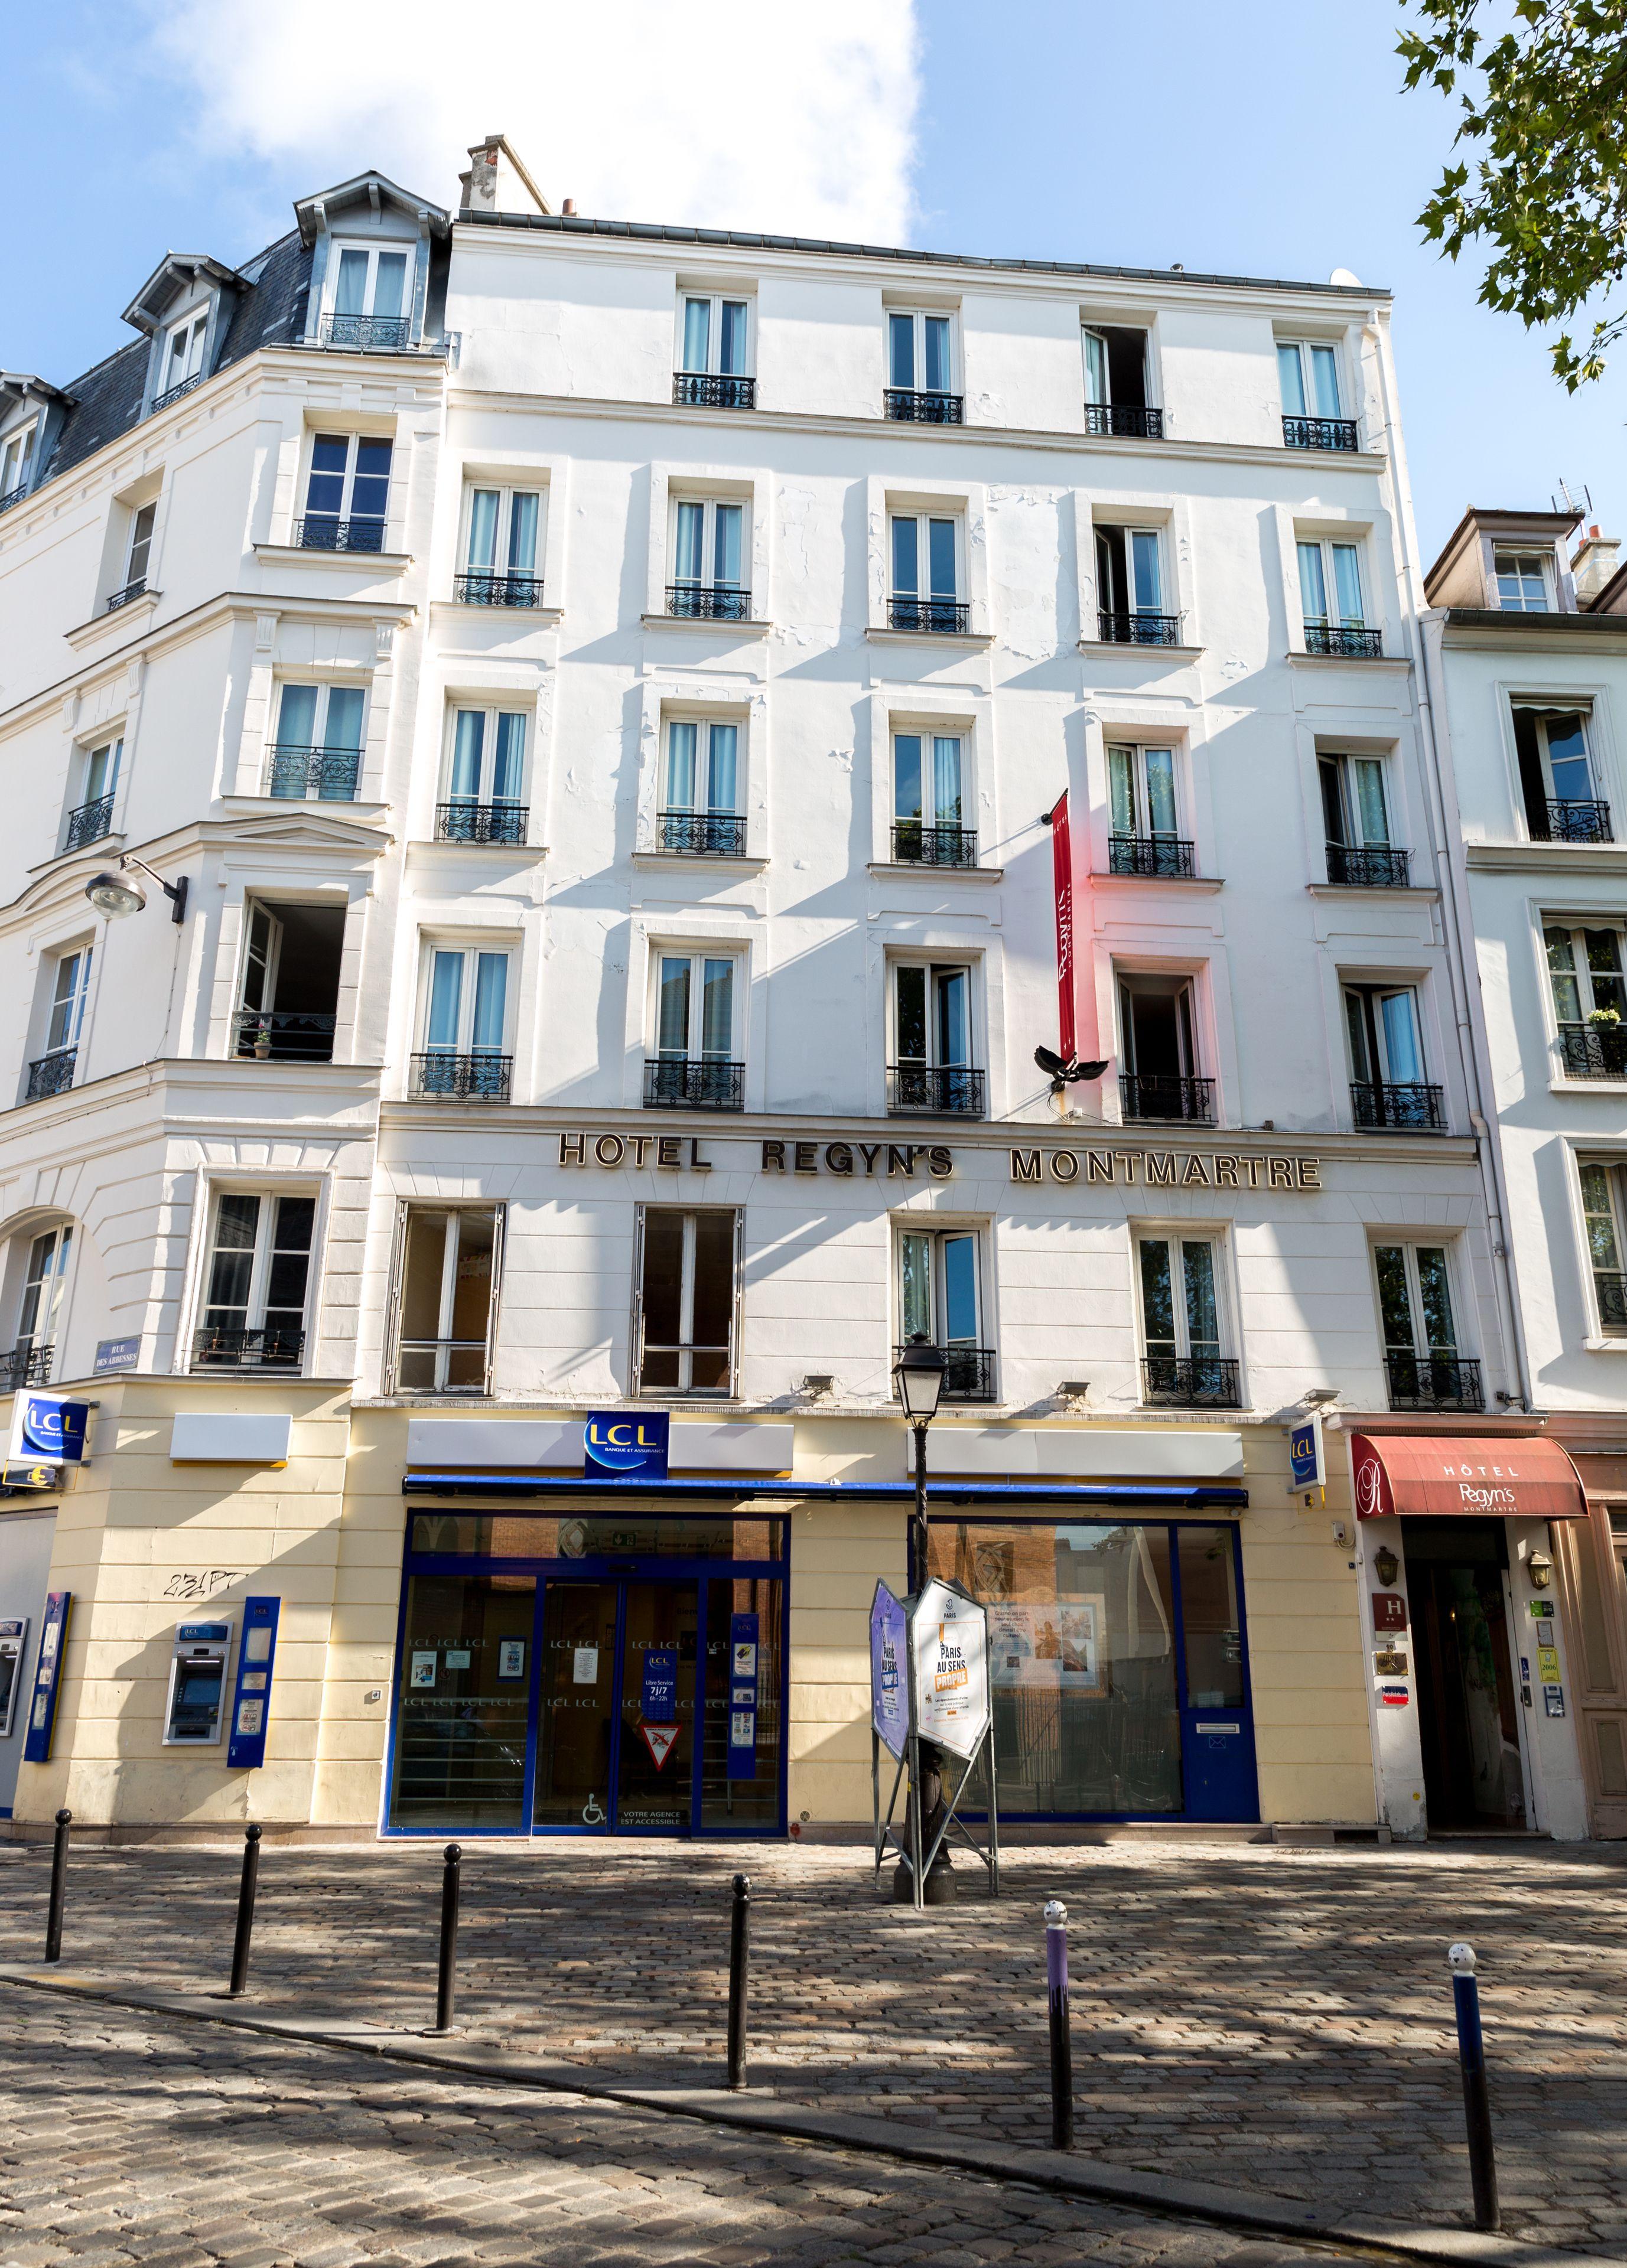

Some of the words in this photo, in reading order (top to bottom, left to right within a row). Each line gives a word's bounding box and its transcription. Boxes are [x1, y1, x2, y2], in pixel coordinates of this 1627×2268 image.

[558, 1132, 712, 1171] HOTEL
[760, 1139, 954, 1179] REGYN'S
[1009, 1148, 1322, 1190] MONTMARTRE
[111, 1344, 125, 1354] RUE
[96, 1358, 108, 1367] DES
[108, 1353, 137, 1365] ABBESSES
[31, 1410, 78, 1433] LCL
[590, 1424, 657, 1446] LCL
[1292, 1438, 1313, 1458] LCL
[1444, 1464, 1519, 1477] HÔTEL
[1356, 1458, 1383, 1514] R
[1459, 1483, 1515, 1507] Regyn's
[1387, 1601, 1403, 1615] H
[409, 1639, 434, 1647] LCL
[437, 1639, 461, 1647] LCL
[466, 1639, 490, 1647] LCL
[551, 1640, 574, 1648] LCL
[578, 1640, 603, 1648] LCL
[632, 1641, 656, 1649] LCL
[660, 1641, 684, 1650] LCL
[884, 1647, 894, 1659] PARIS
[941, 1647, 962, 1660] PARIS
[937, 1661, 946, 1673] AU
[948, 1660, 966, 1672] SENS
[936, 1670, 967, 1689] PROPRE
[650, 1687, 668, 1696] 7j/7
[404, 1698, 428, 1706] LCL
[432, 1698, 457, 1706] LCL
[461, 1698, 486, 1706] LCL
[490, 1698, 515, 1706] LCL
[548, 1699, 571, 1707] LCL
[575, 1699, 600, 1707] LCL
